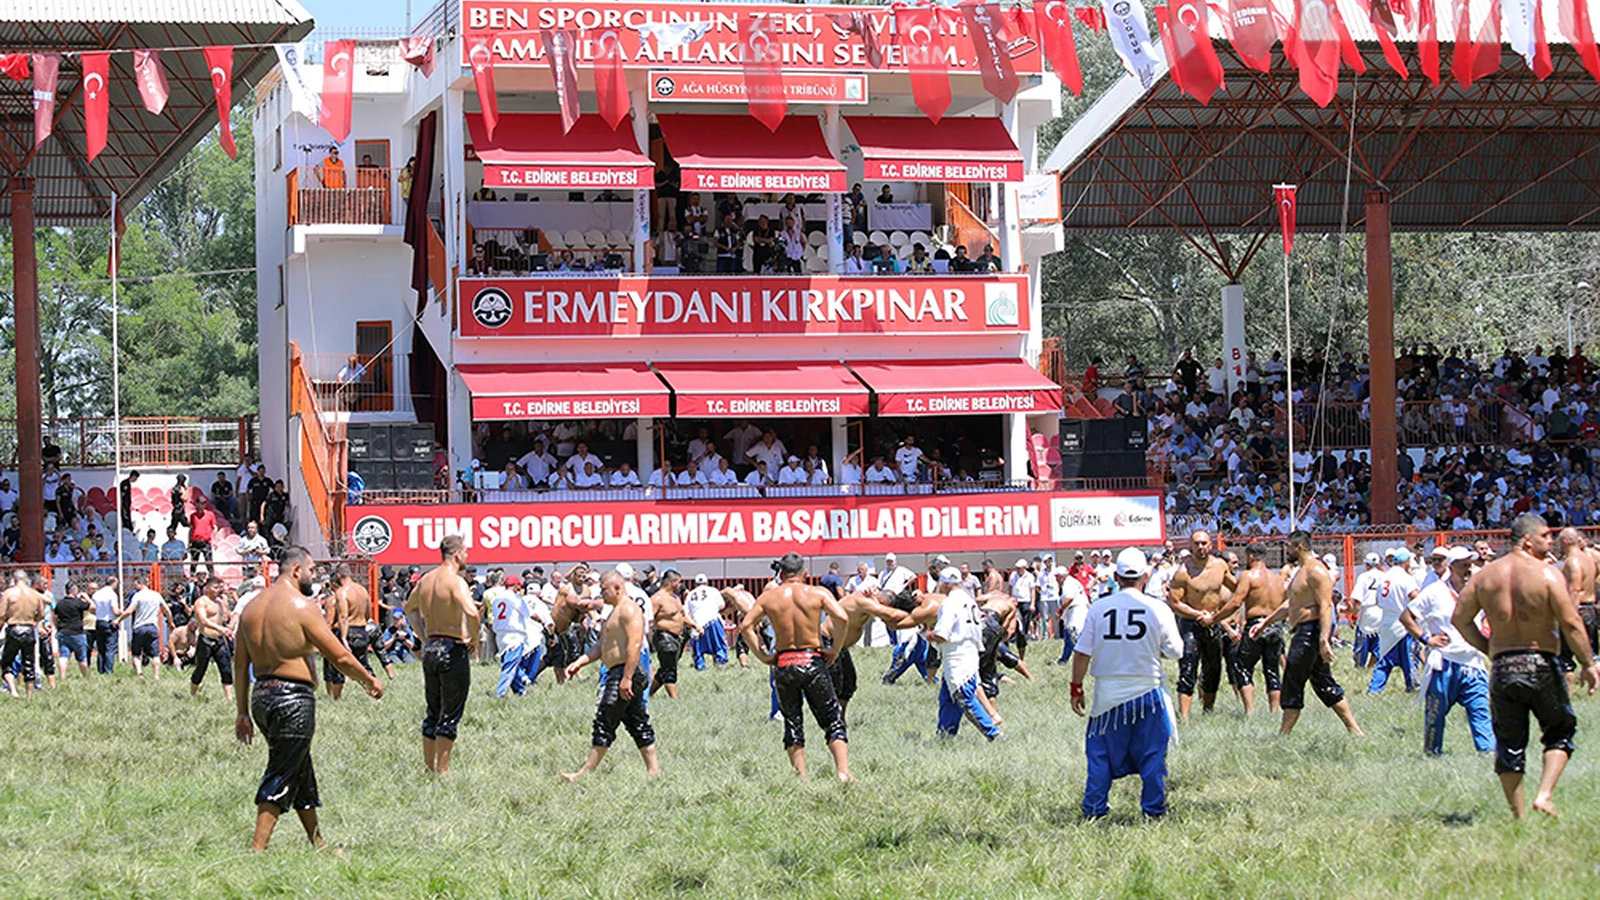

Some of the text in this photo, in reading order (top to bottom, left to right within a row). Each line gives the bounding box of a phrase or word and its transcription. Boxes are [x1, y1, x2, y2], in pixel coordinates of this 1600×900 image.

[469, 8, 528, 29] BEN
[538, 8, 738, 33] SPORCUNUN
[748, 8, 822, 41] ZEKİ,
[682, 82, 704, 94] AĞA
[706, 81, 752, 95] HÜSEYİN
[791, 82, 838, 96] TRİBÜNÜ
[500, 168, 638, 185] T.C. EDİRNE BELEDİYESİ
[879, 163, 1008, 180] T.C. EDİRNE BELEDİYESİ
[697, 172, 830, 190] T.C. EDİRNE BELEDİYESİ
[524, 289, 968, 324] ERMEYDANI KIRKPINAR
[503, 398, 640, 415] T.C. EDİRNE BELEDİYESİ
[706, 397, 840, 413] T.C. EDİRNE BELEDİYESİ
[906, 394, 1034, 412] T.C. EDİRNE BELEDİYESİ
[403, 505, 1040, 549] TÜM SPORCULARIMIZA BAŞARILAR DİLERİM
[1381, 579, 1391, 598] 3
[497, 601, 507, 620] 2
[1103, 608, 1147, 641] 15
